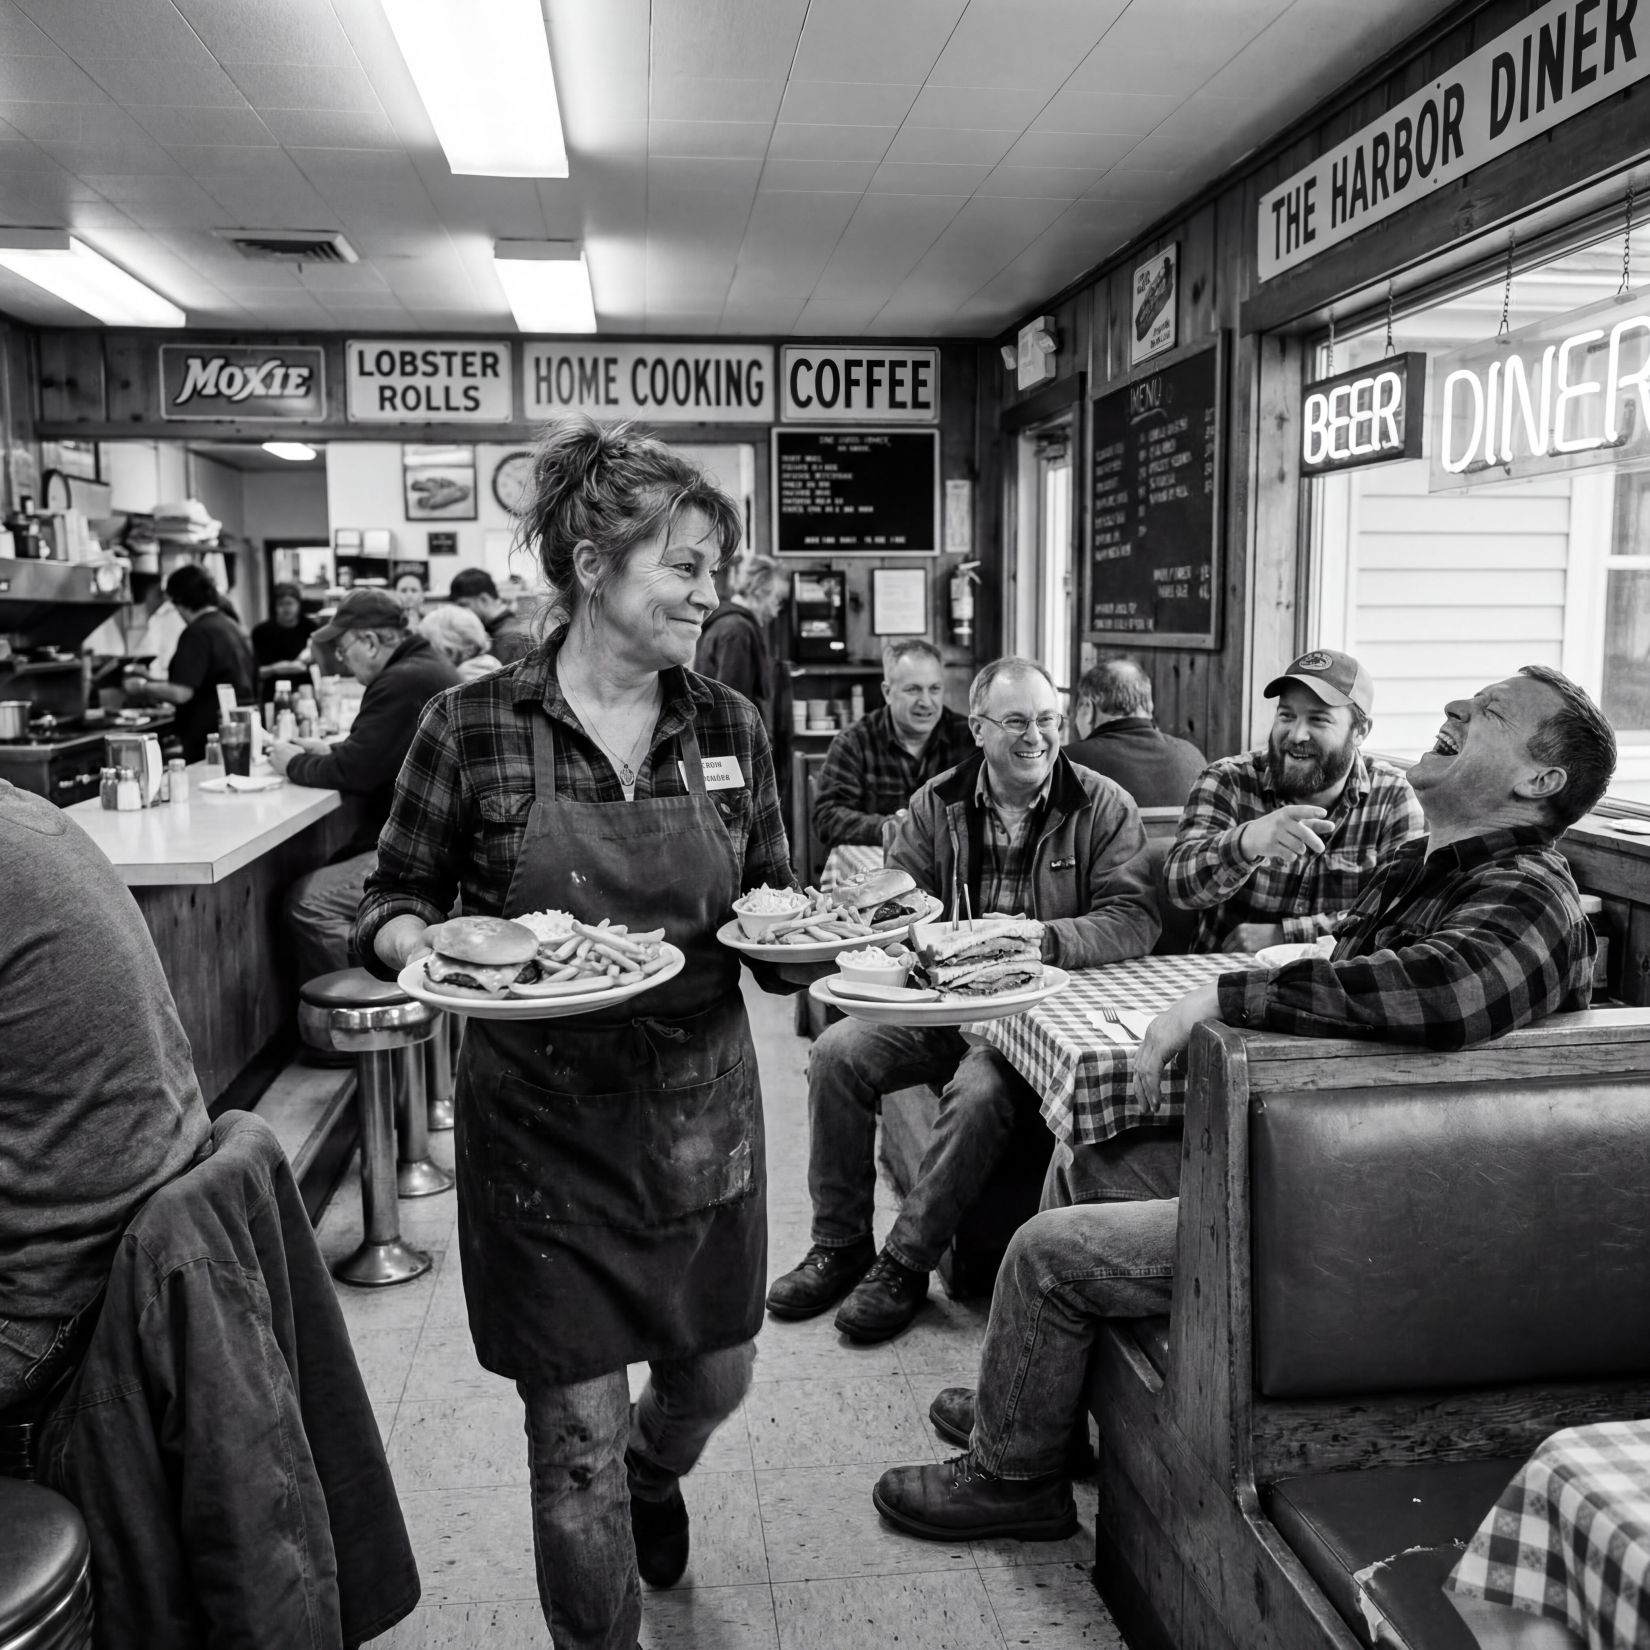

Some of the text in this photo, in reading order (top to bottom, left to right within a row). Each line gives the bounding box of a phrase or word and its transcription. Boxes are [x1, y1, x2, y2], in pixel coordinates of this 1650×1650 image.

[1272, 0, 1637, 260] THE HARBOR DINER
[174, 357, 310, 405] MOXIE
[357, 350, 500, 378] LOBSTER
[534, 356, 764, 408] HOME COOKING
[790, 358, 931, 410] COFFEE
[378, 385, 480, 412] ROLLS
[1303, 371, 1402, 465] BEER
[1442, 315, 1650, 473] DINER
